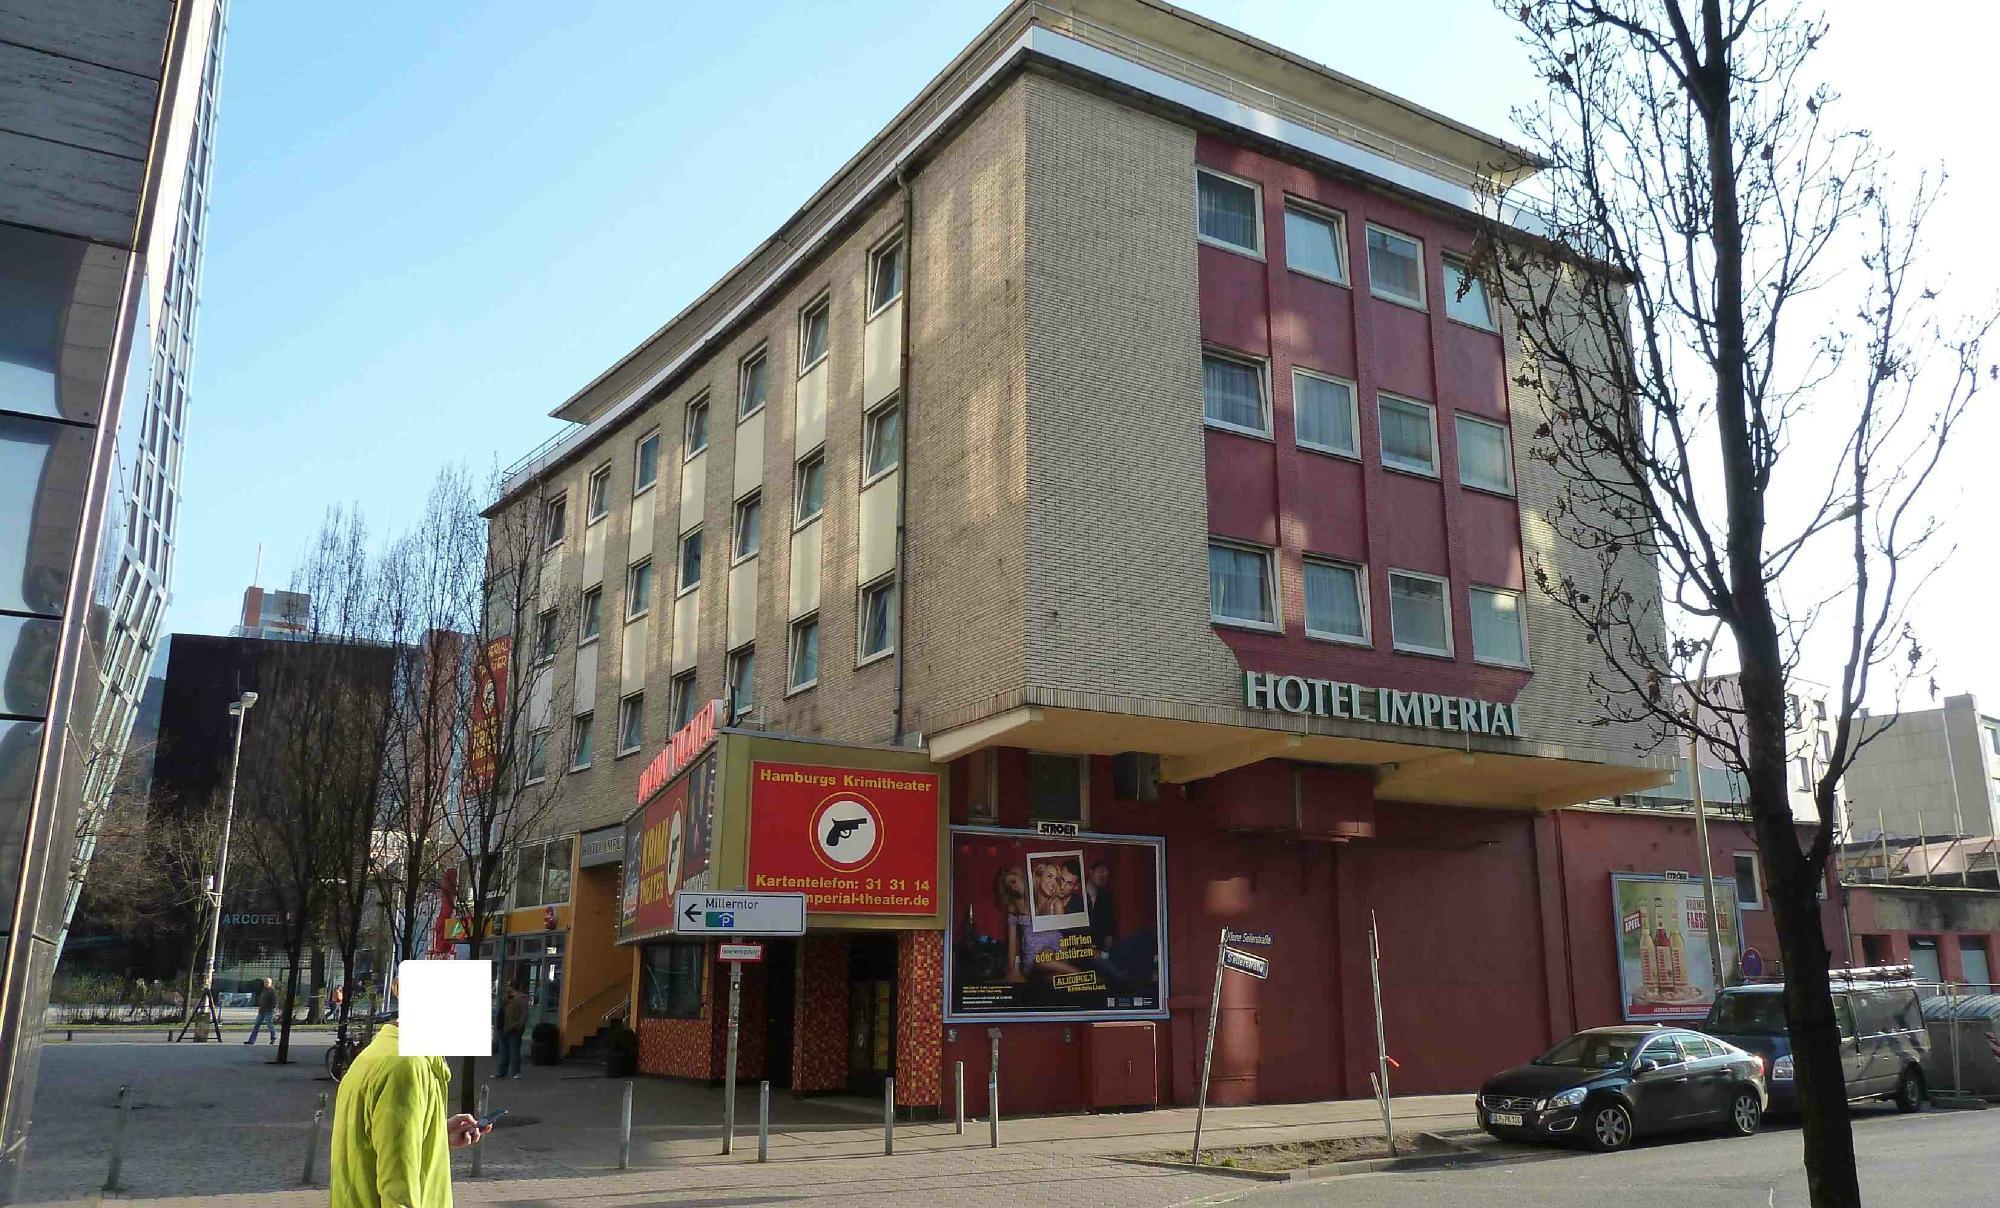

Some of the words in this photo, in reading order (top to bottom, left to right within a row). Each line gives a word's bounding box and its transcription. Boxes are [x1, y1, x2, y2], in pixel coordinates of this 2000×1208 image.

[1243, 671, 1376, 723] HOTEL
[1377, 687, 1523, 737] IMPERIAL
[760, 769, 836, 786] Hamburgs
[843, 775, 932, 792] Krimitheater
[581, 841, 602, 857] HOTEL
[604, 836, 624, 853] IMPE
[756, 874, 859, 889] Kartentelefon:
[865, 879, 882, 890] 31
[889, 879, 906, 891] 31
[914, 880, 930, 891] 14
[705, 897, 760, 911] Millerntor
[804, 892, 930, 906] mperial-theater.de
[222, 913, 282, 925] ARCOTEL
[1059, 934, 1092, 947] anflirten
[1035, 952, 1053, 963] oder
[1055, 947, 1094, 961] abstürzen
